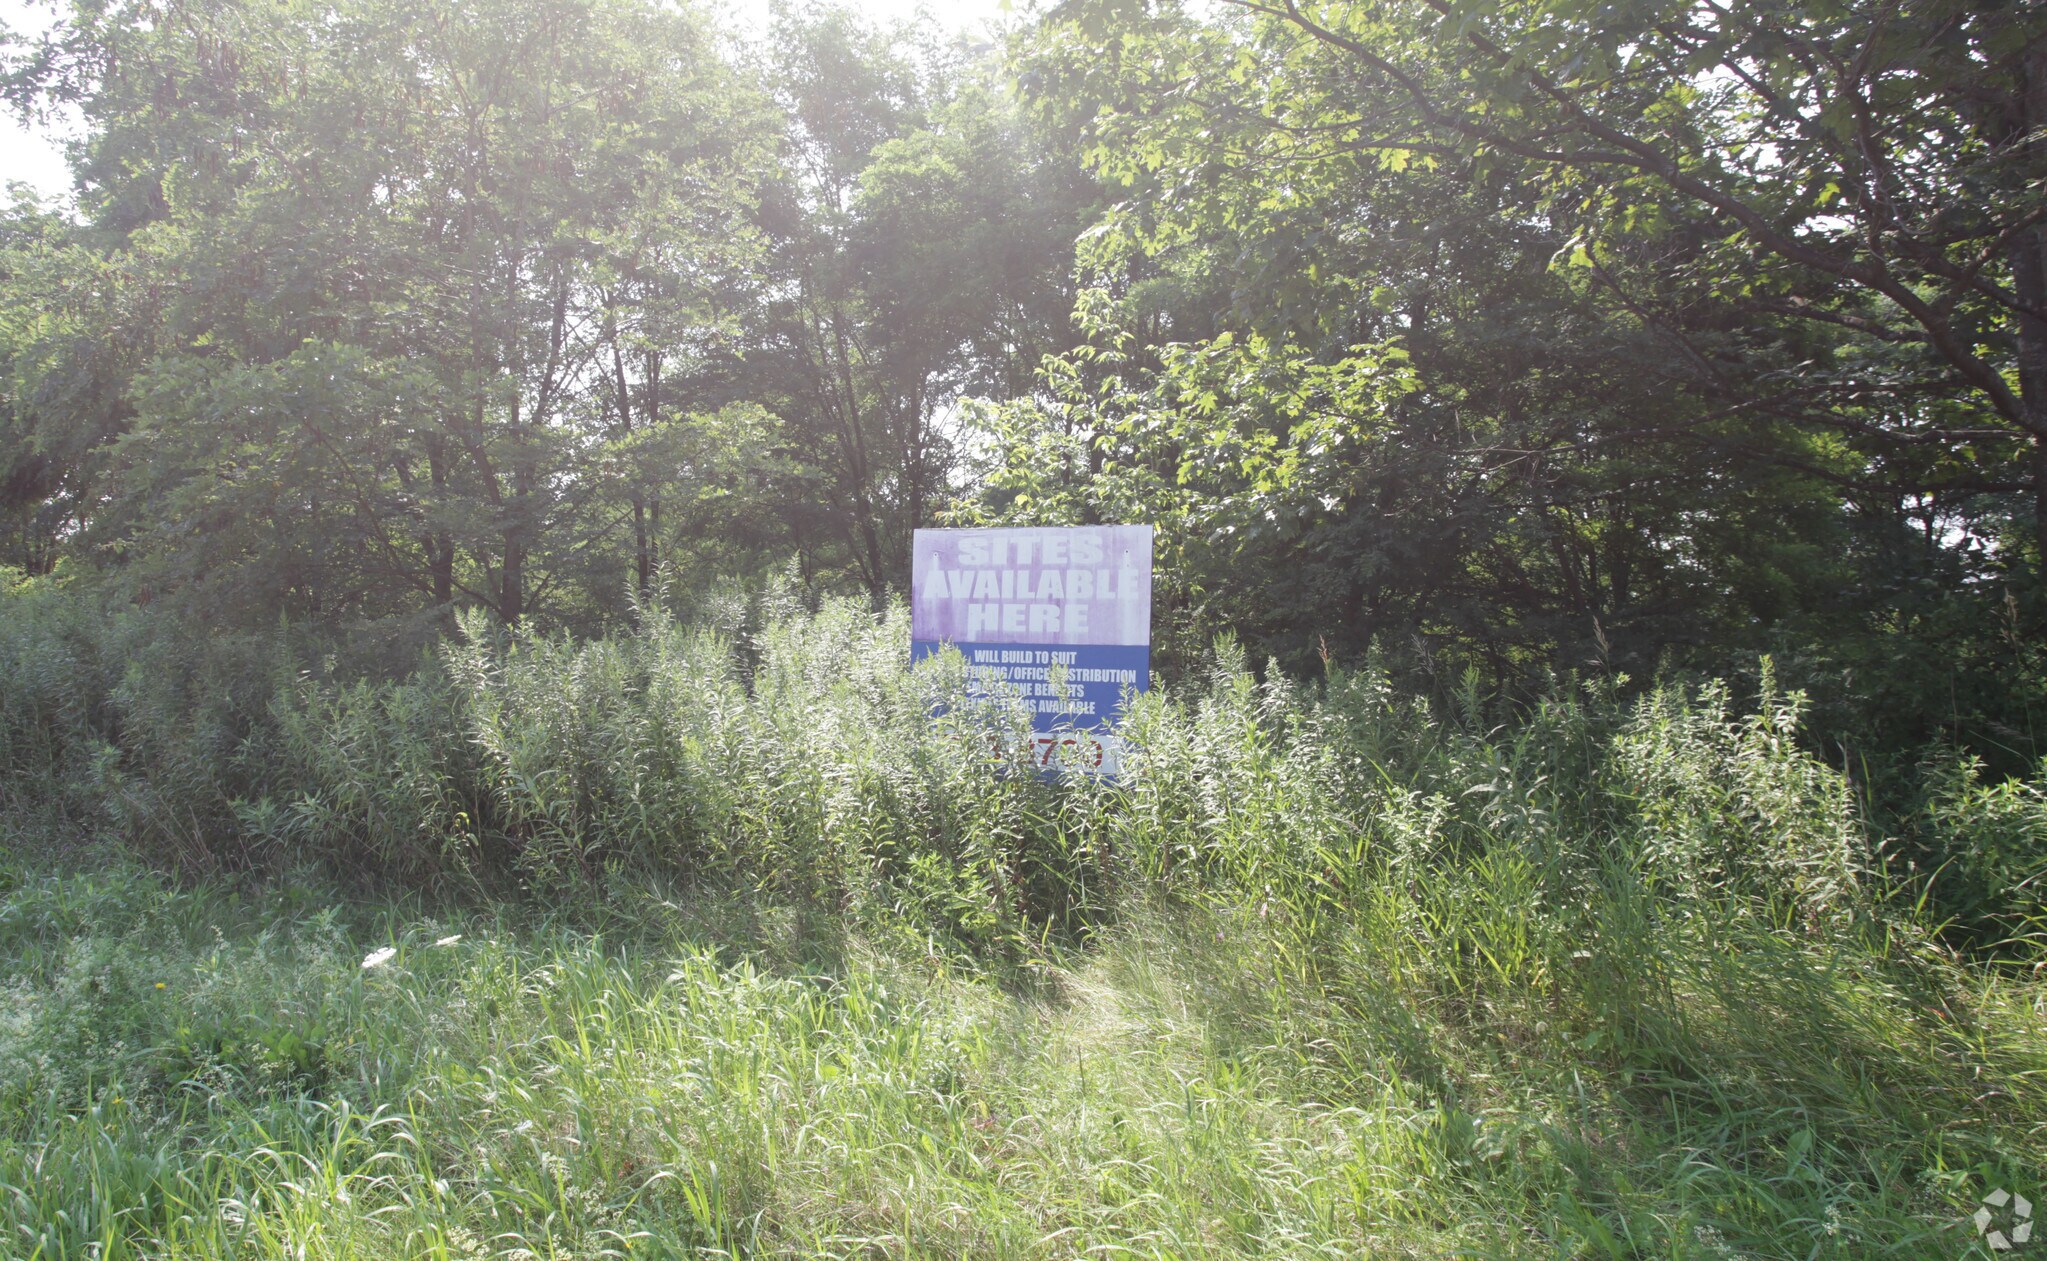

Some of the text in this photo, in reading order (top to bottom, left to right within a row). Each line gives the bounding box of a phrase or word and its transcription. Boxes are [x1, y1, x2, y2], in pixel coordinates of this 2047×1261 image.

[958, 533, 1103, 565] SITES
[923, 569, 1139, 599] AVAILABLE
[968, 603, 1089, 633] HERE
[974, 650, 1077, 665] WILL BUILD TO SUIT
[1006, 682, 1032, 696] ZONE
[1034, 683, 1085, 698] BENITS
[1038, 699, 1096, 715] AVAILABLE
